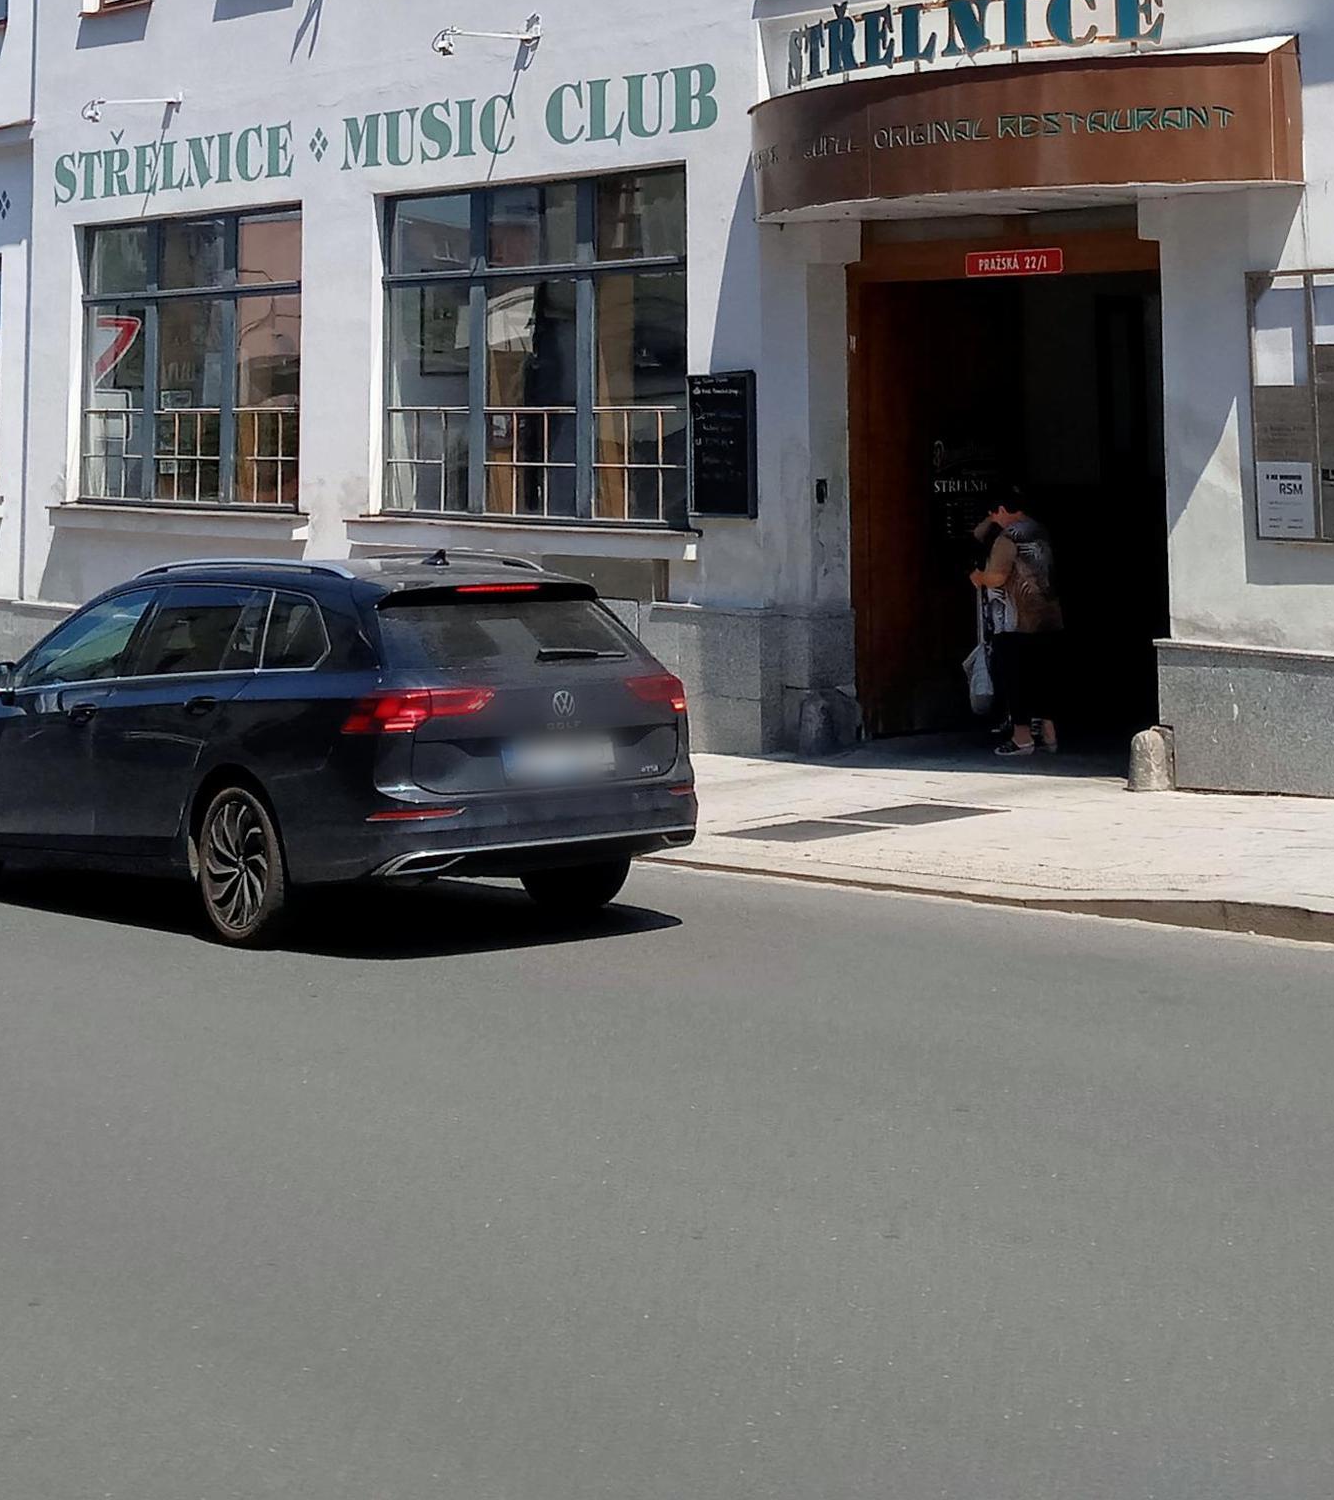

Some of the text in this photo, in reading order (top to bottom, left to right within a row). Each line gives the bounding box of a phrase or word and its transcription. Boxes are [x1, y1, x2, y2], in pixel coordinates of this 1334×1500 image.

[54, 62, 719, 207] STŘELNICE MUSIC CLUB
[874, 116, 989, 150] ORIGINAL
[997, 105, 1236, 139] RESTAURANT
[977, 254, 1048, 274] PRAŽSKÁ 22/1
[1279, 483, 1303, 495] RSM
